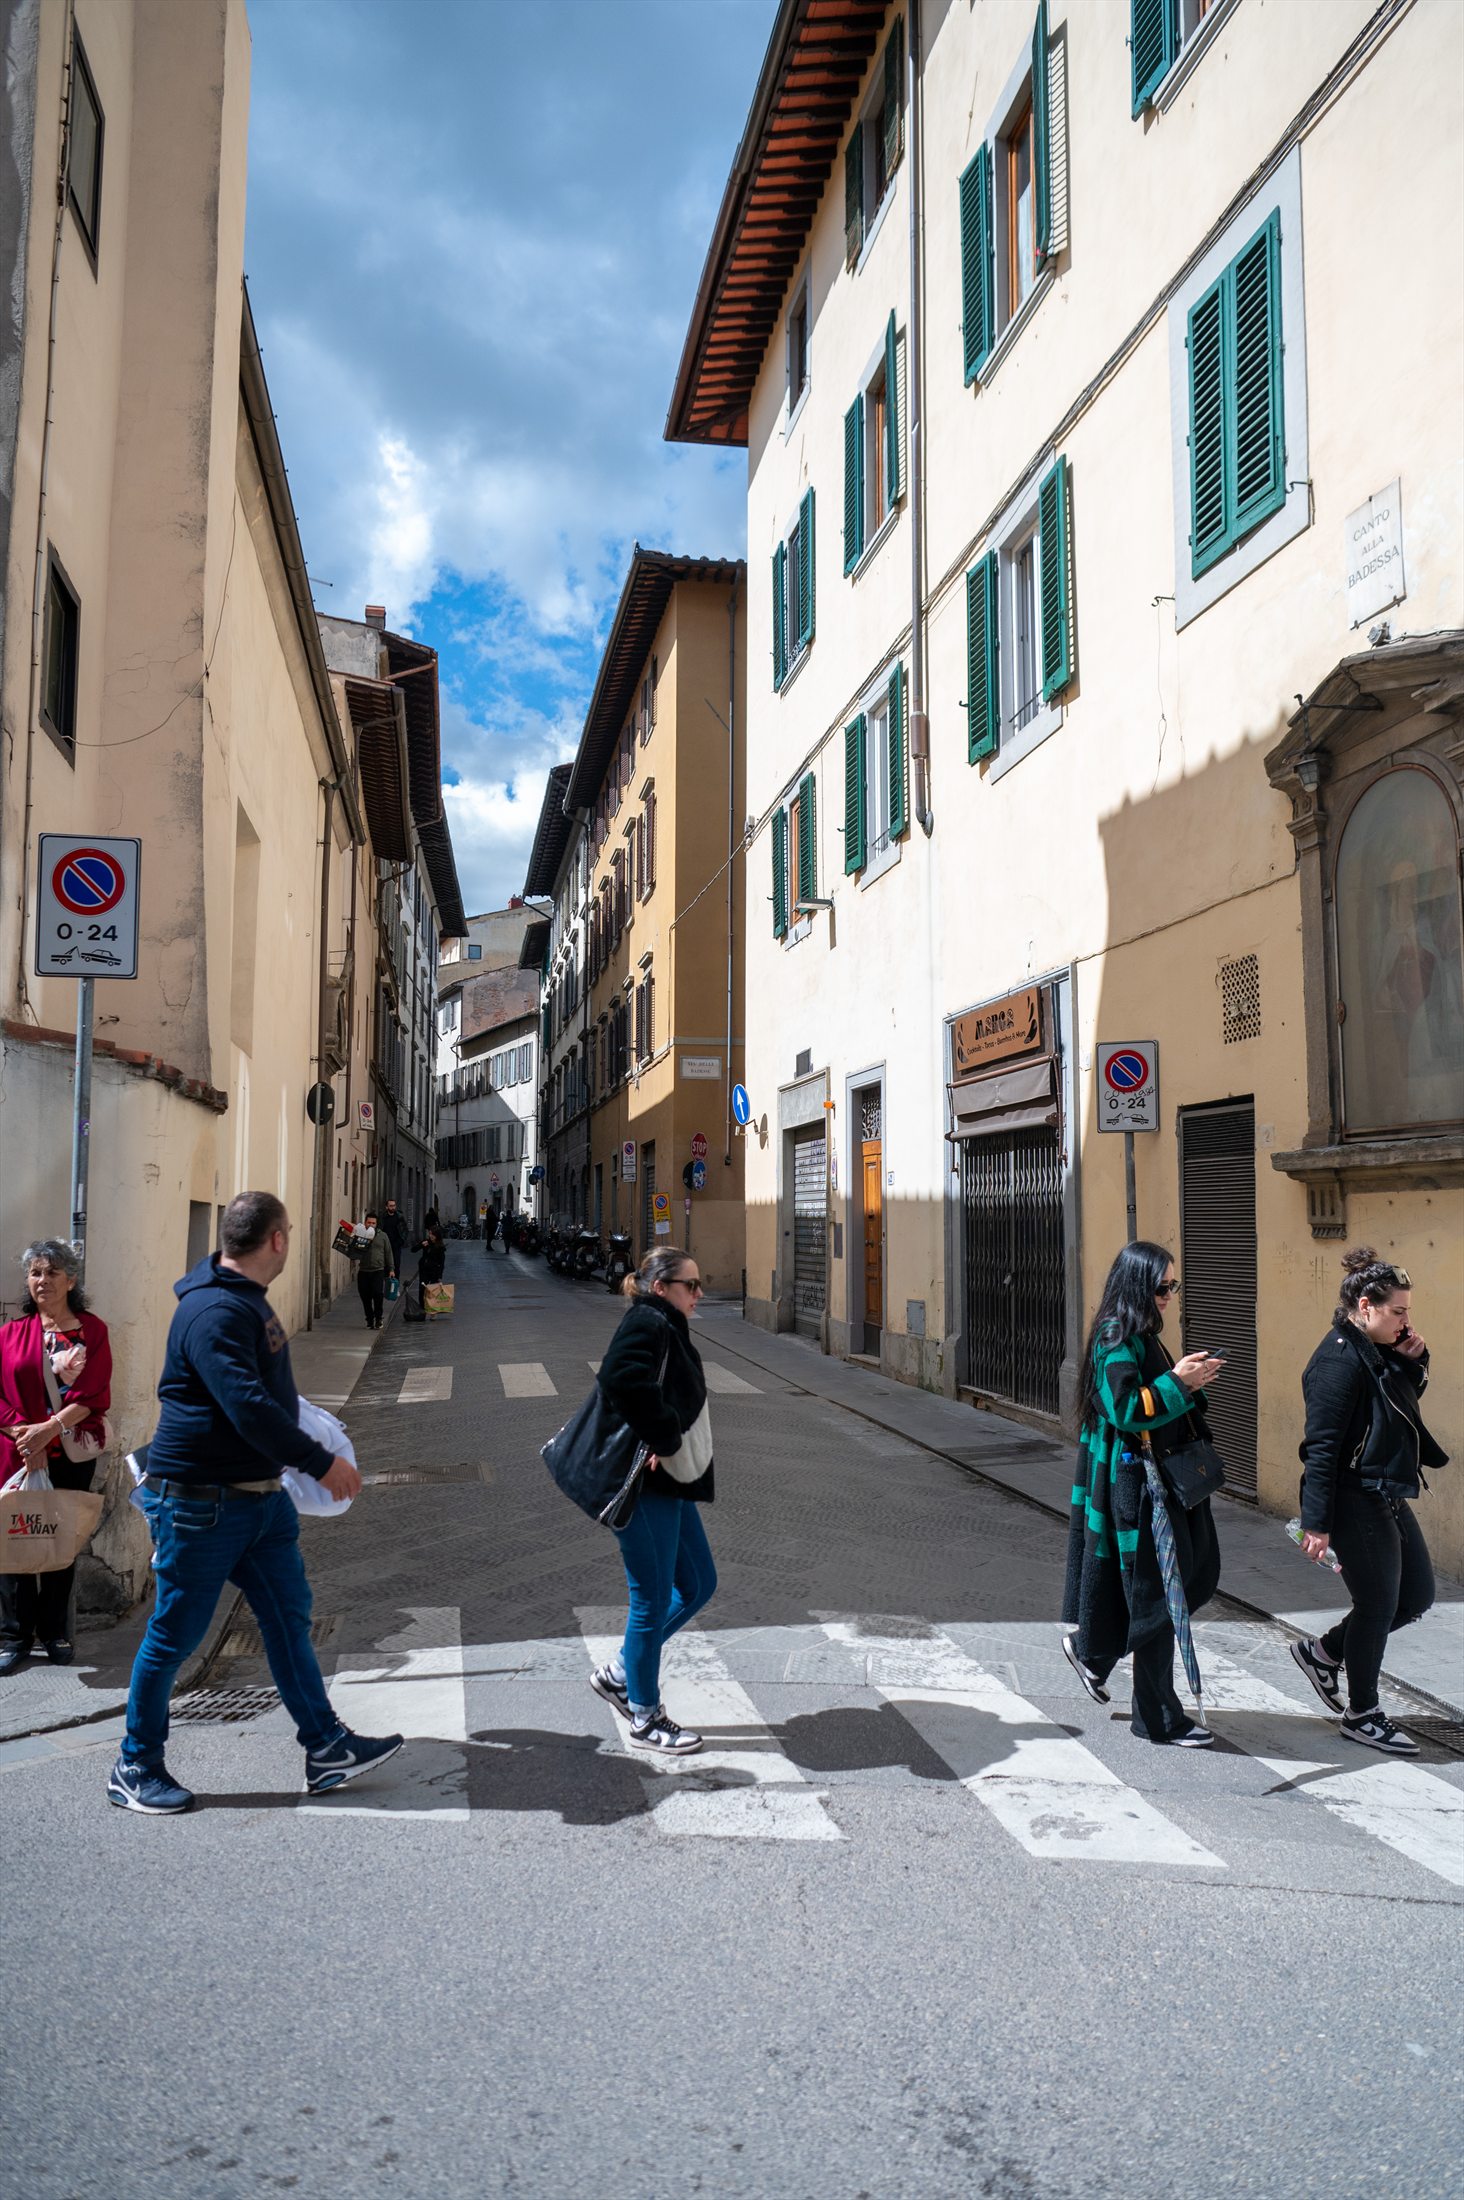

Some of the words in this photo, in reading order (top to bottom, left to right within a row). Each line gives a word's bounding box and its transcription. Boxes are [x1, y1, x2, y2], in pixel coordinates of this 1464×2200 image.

[1353, 508, 1391, 542] CANTO
[1361, 535, 1384, 556] ALLA
[1348, 545, 1400, 589] BADESSA
[692, 1141, 708, 1153] STOP
